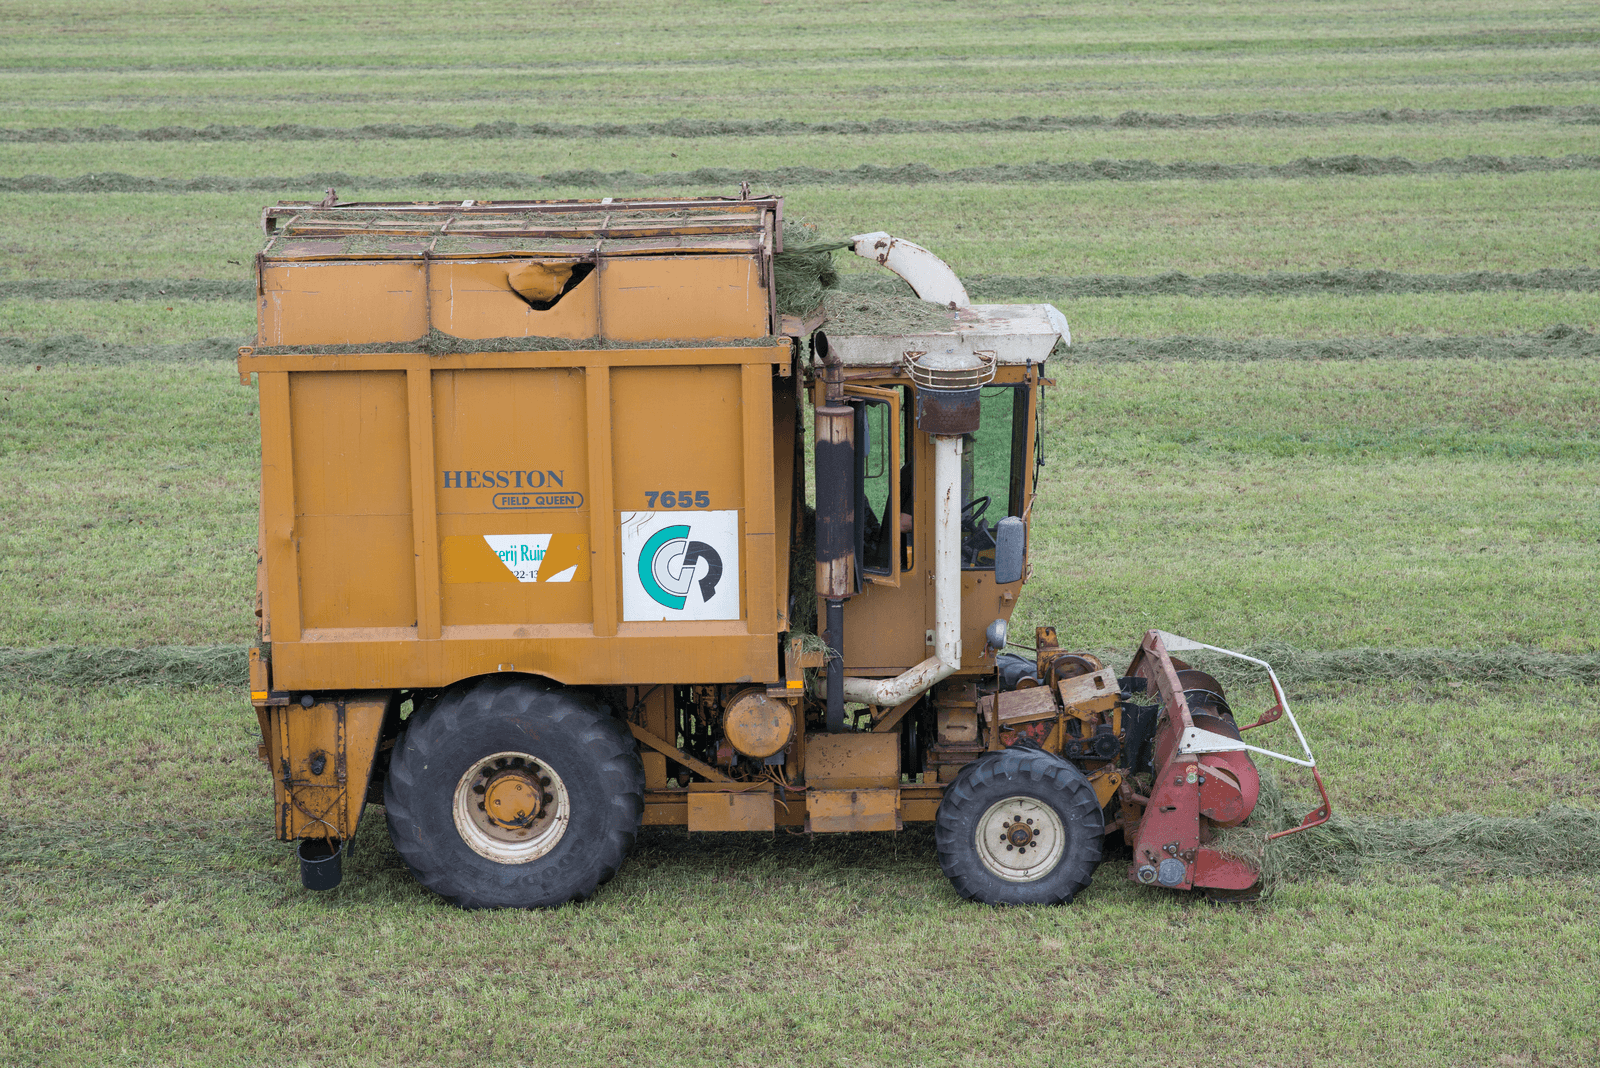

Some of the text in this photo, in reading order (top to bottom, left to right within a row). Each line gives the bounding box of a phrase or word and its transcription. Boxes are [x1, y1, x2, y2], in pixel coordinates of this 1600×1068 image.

[441, 469, 565, 489] HESSTON
[501, 495, 575, 506] FIELD QUEEN
[644, 490, 710, 509] 7655
[494, 544, 518, 567] erij
[510, 569, 539, 579] 22-13
